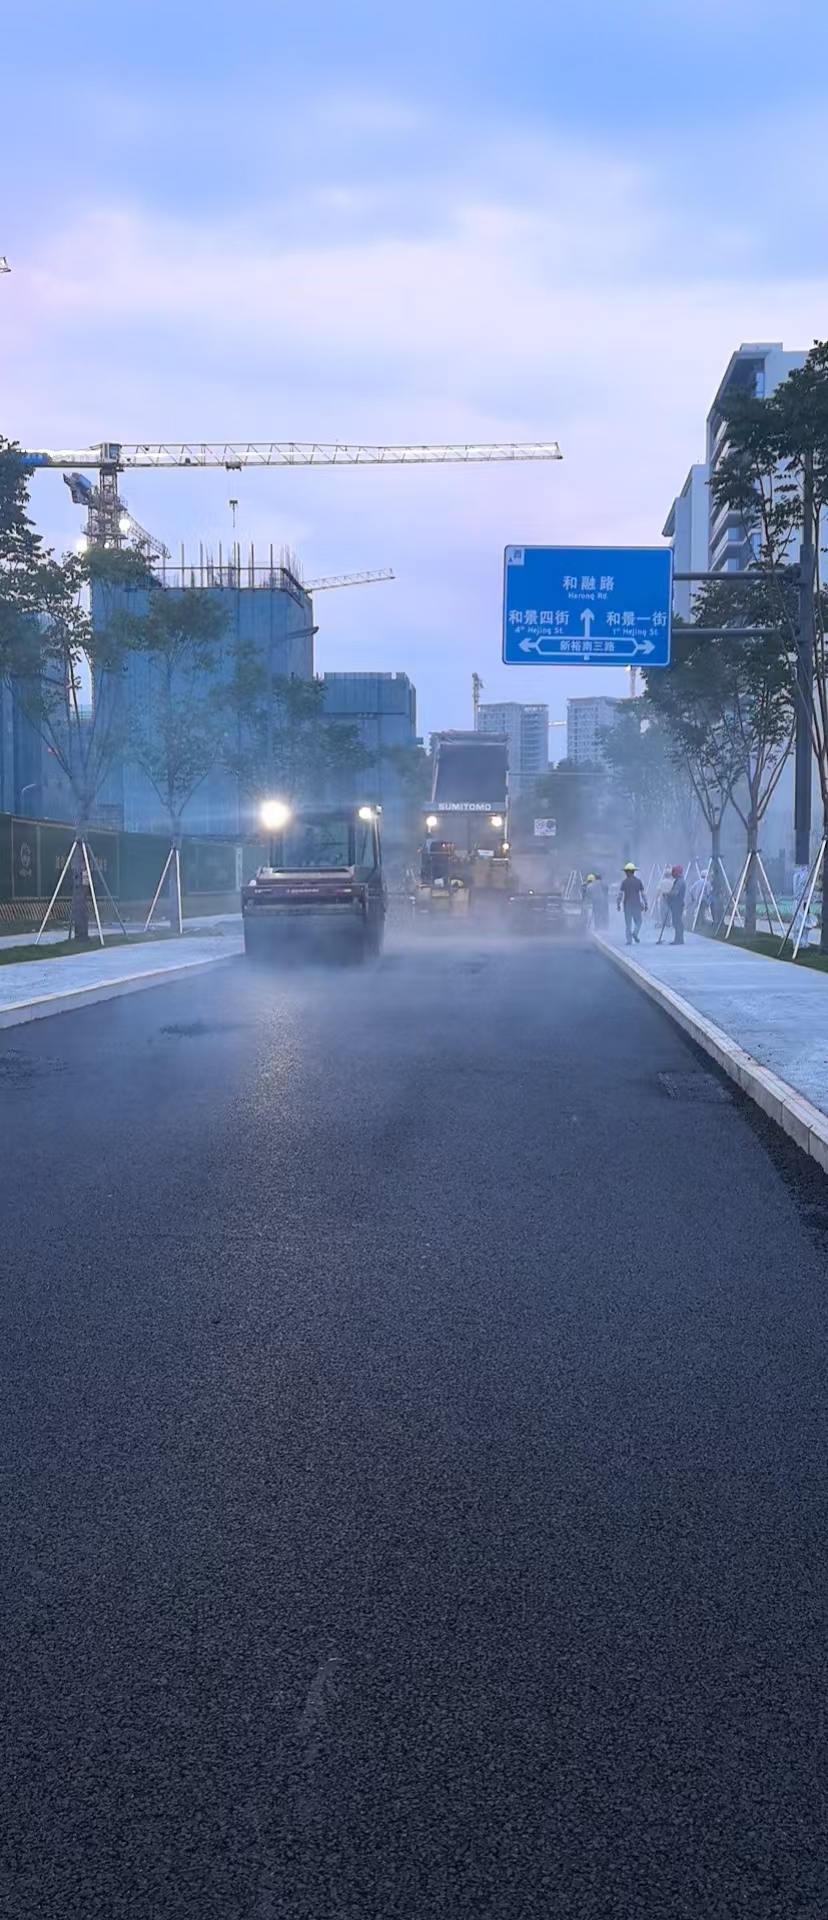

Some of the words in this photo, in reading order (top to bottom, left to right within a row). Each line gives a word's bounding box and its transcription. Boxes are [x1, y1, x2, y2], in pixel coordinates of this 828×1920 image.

[563, 575, 614, 591] 和融路
[568, 592, 594, 600] Herong
[508, 609, 569, 625] 和景四街
[606, 611, 667, 627] 和景一街
[528, 627, 551, 636] Hejing
[623, 628, 646, 637] Hejing
[560, 640, 615, 652] 新裕南三路
[438, 803, 491, 811] SUMITOMO
